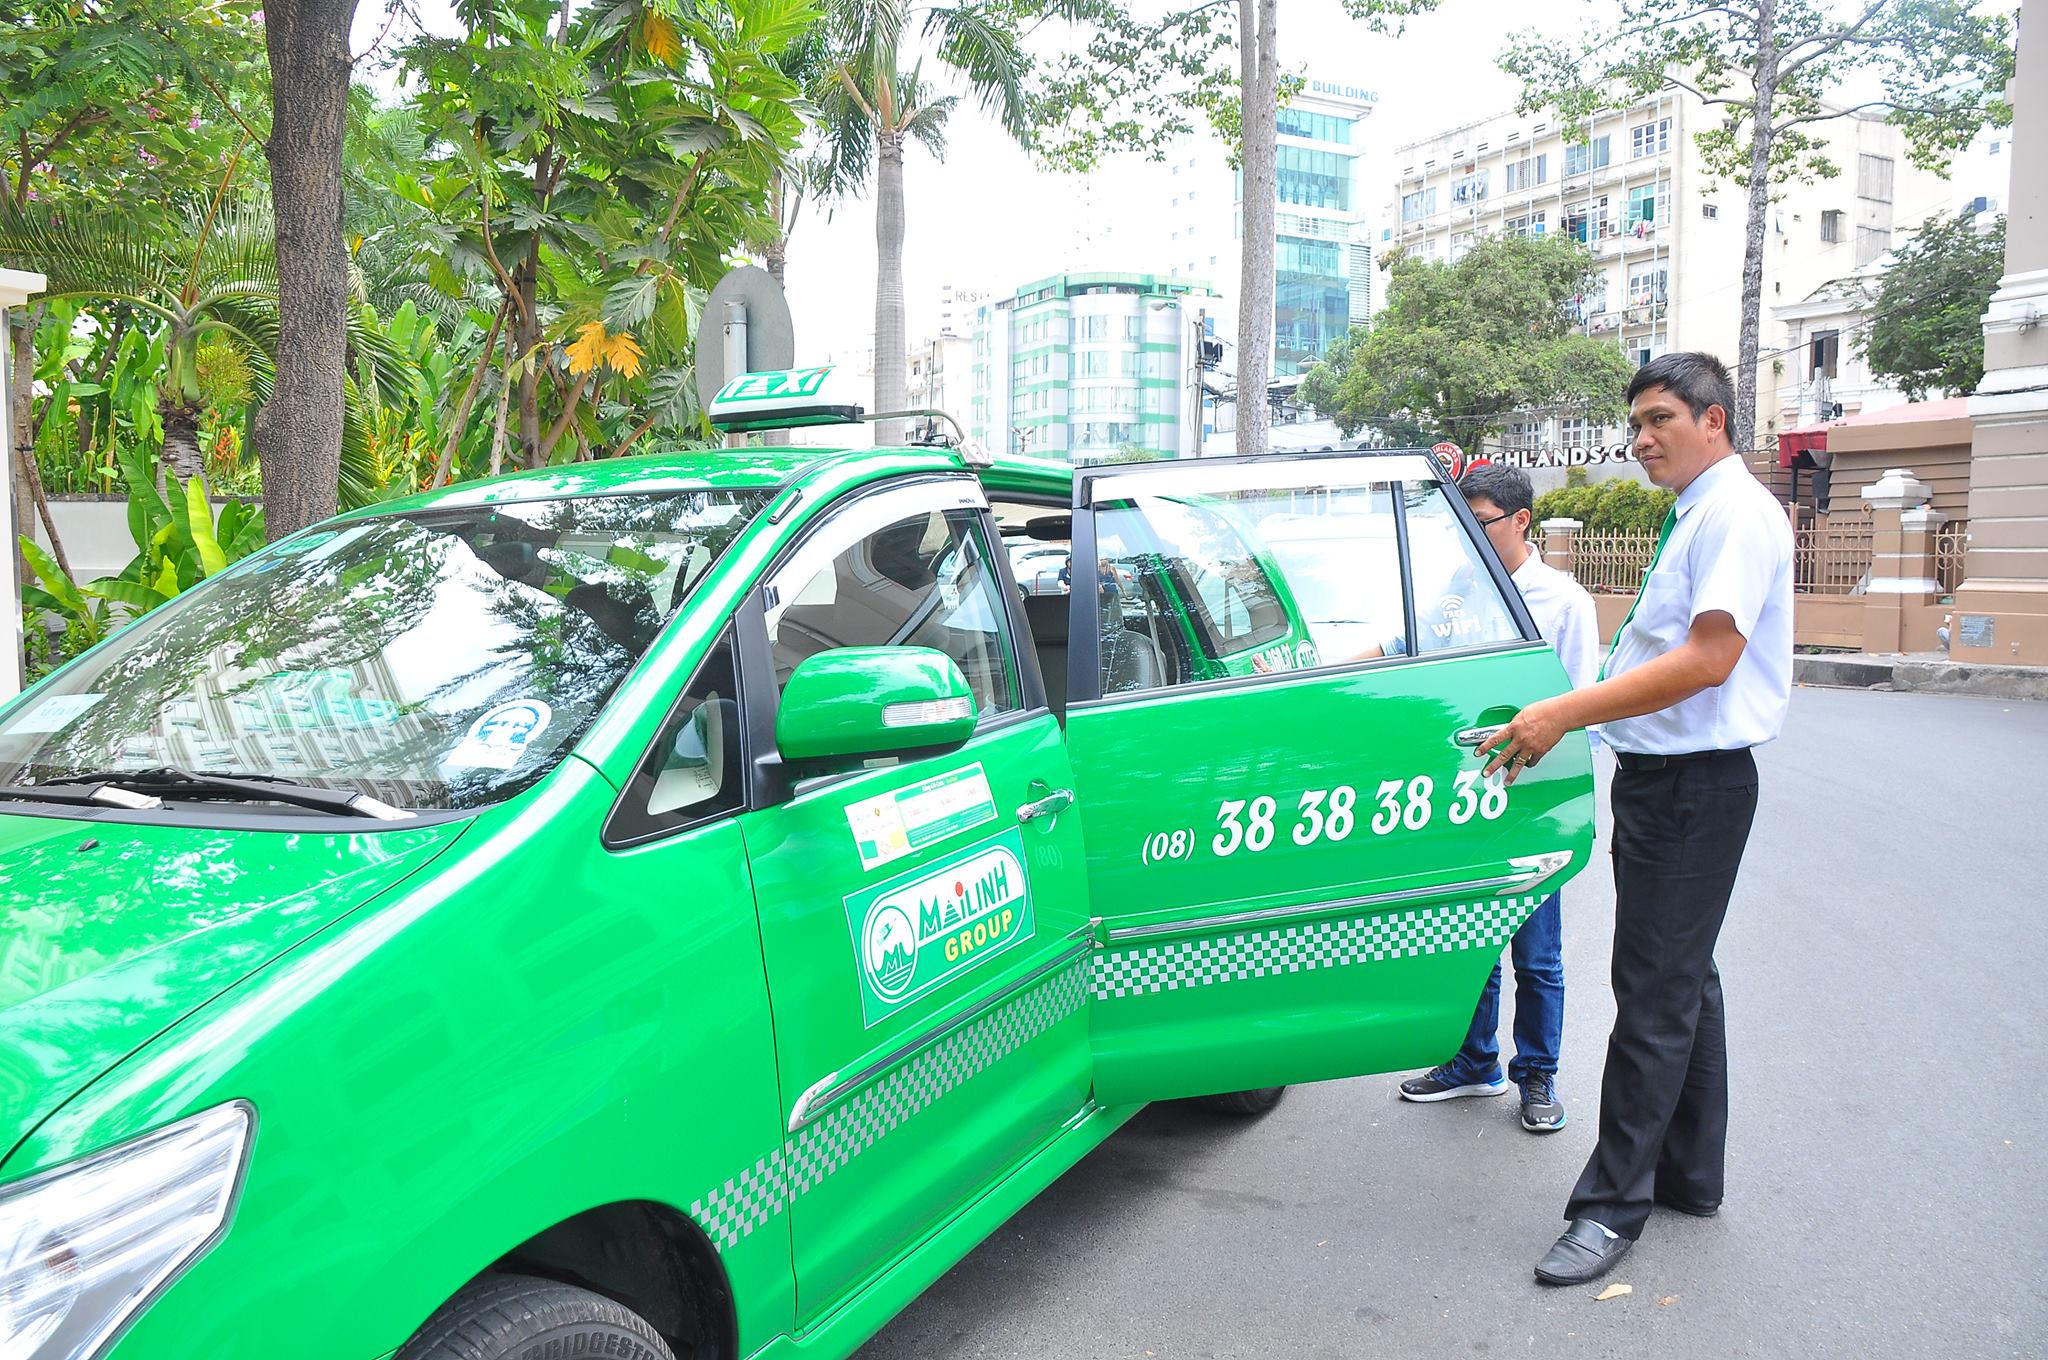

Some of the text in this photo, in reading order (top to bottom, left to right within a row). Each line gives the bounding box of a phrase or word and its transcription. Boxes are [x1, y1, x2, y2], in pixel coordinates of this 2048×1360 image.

[1312, 80, 1379, 103] BUILDING
[1142, 765, 1509, 866] (08) 38 38 38 38
[944, 908, 1013, 962] GROUP
